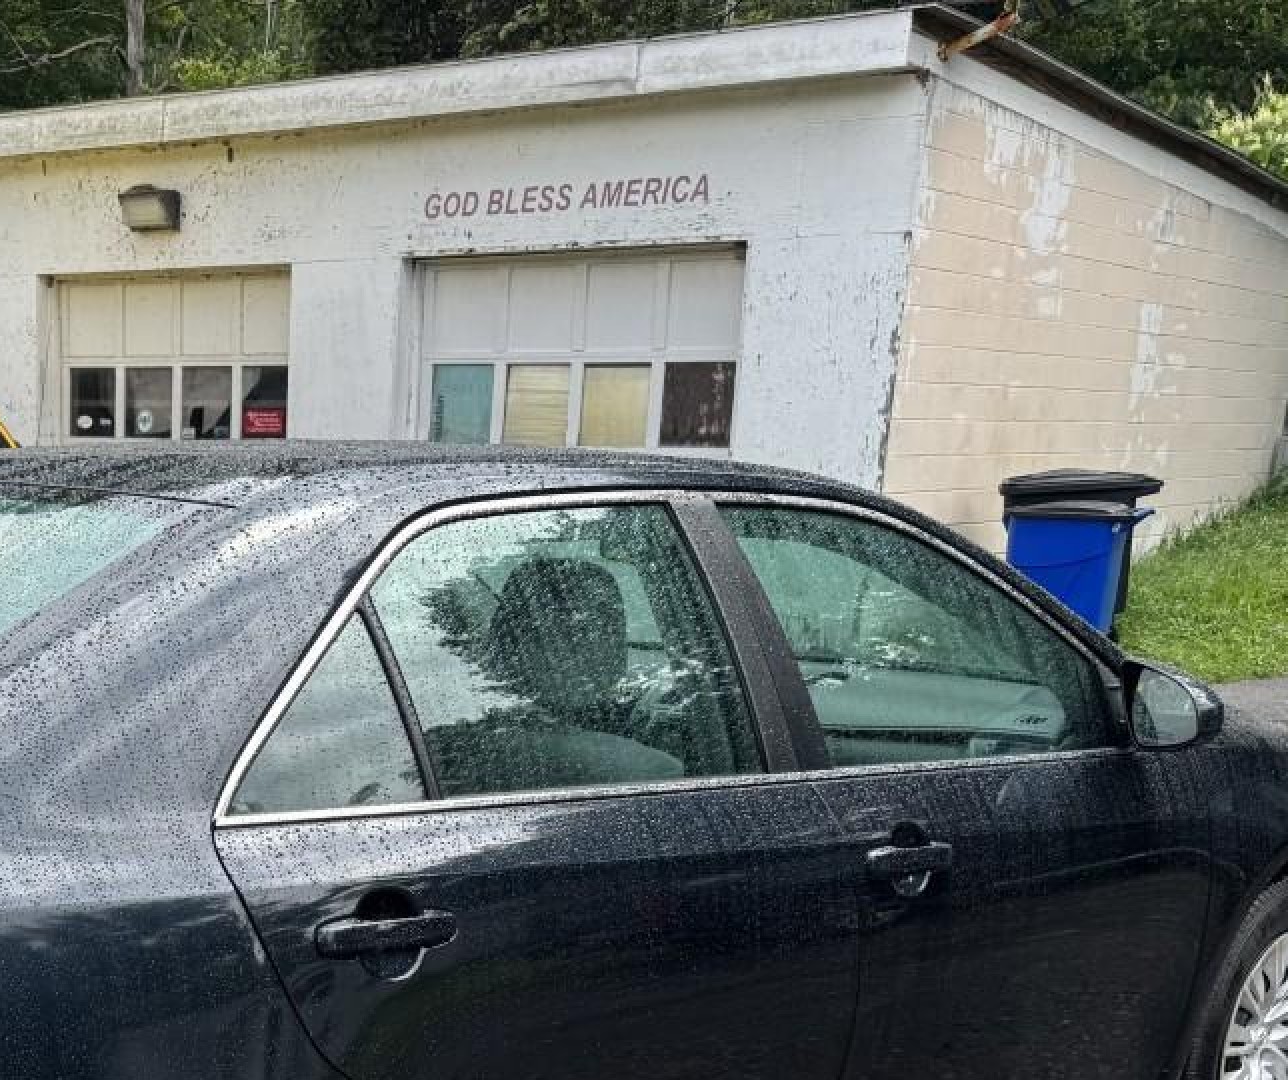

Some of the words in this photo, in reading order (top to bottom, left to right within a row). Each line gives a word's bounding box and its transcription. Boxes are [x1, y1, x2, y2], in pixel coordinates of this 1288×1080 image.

[424, 192, 479, 219] GOD
[486, 184, 573, 215] BLESS
[580, 173, 710, 209] AMERICA
